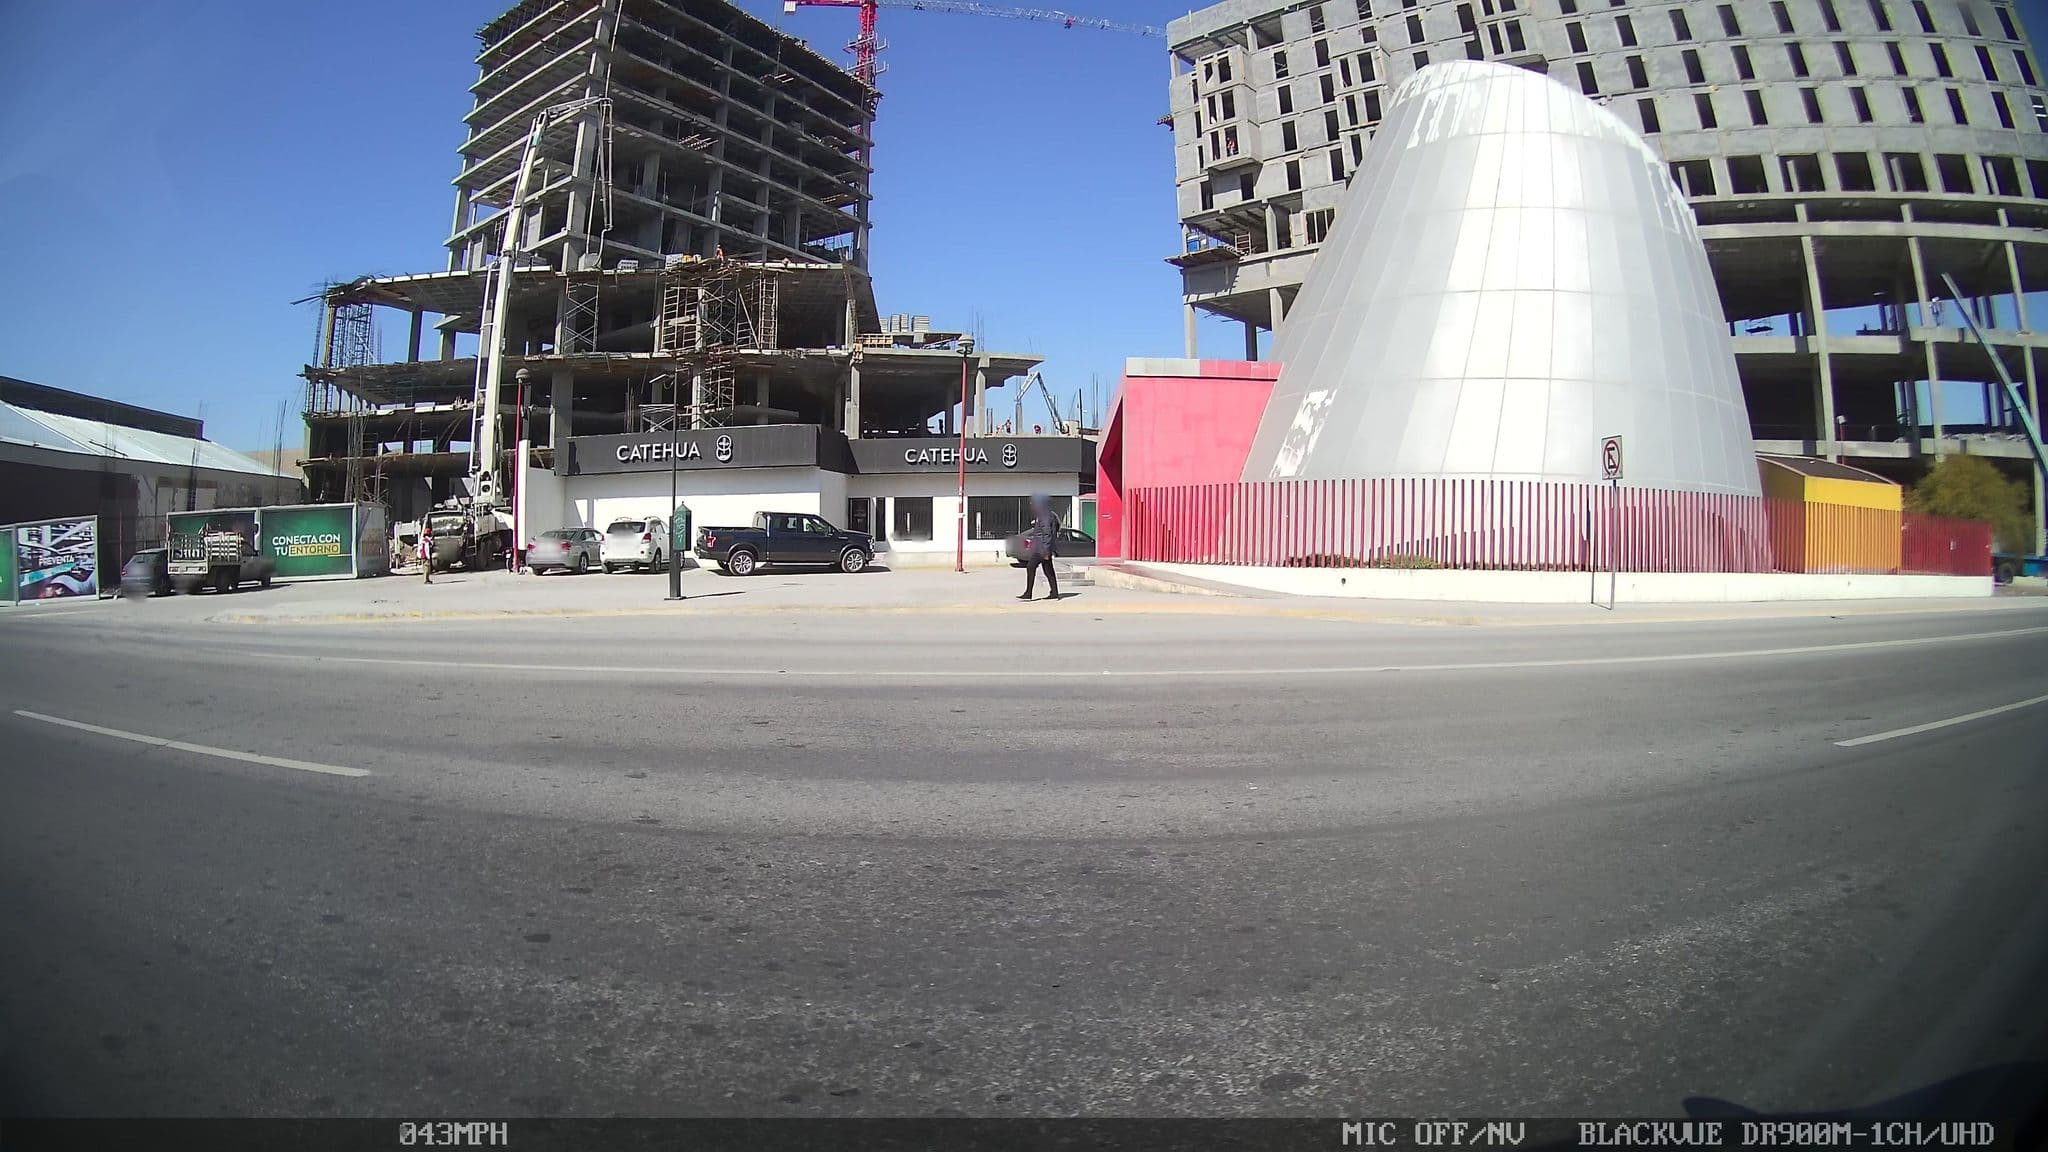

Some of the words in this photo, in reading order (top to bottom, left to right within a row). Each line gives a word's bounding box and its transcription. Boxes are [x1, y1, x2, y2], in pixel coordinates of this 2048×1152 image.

[616, 441, 701, 461] CATEHUA
[904, 447, 988, 463] CATEHUA
[272, 534, 318, 546] CONECTA
[318, 533, 341, 543] CON
[274, 546, 288, 556] TU
[290, 544, 339, 555] ENTORNO
[38, 555, 75, 567] PREVENTA
